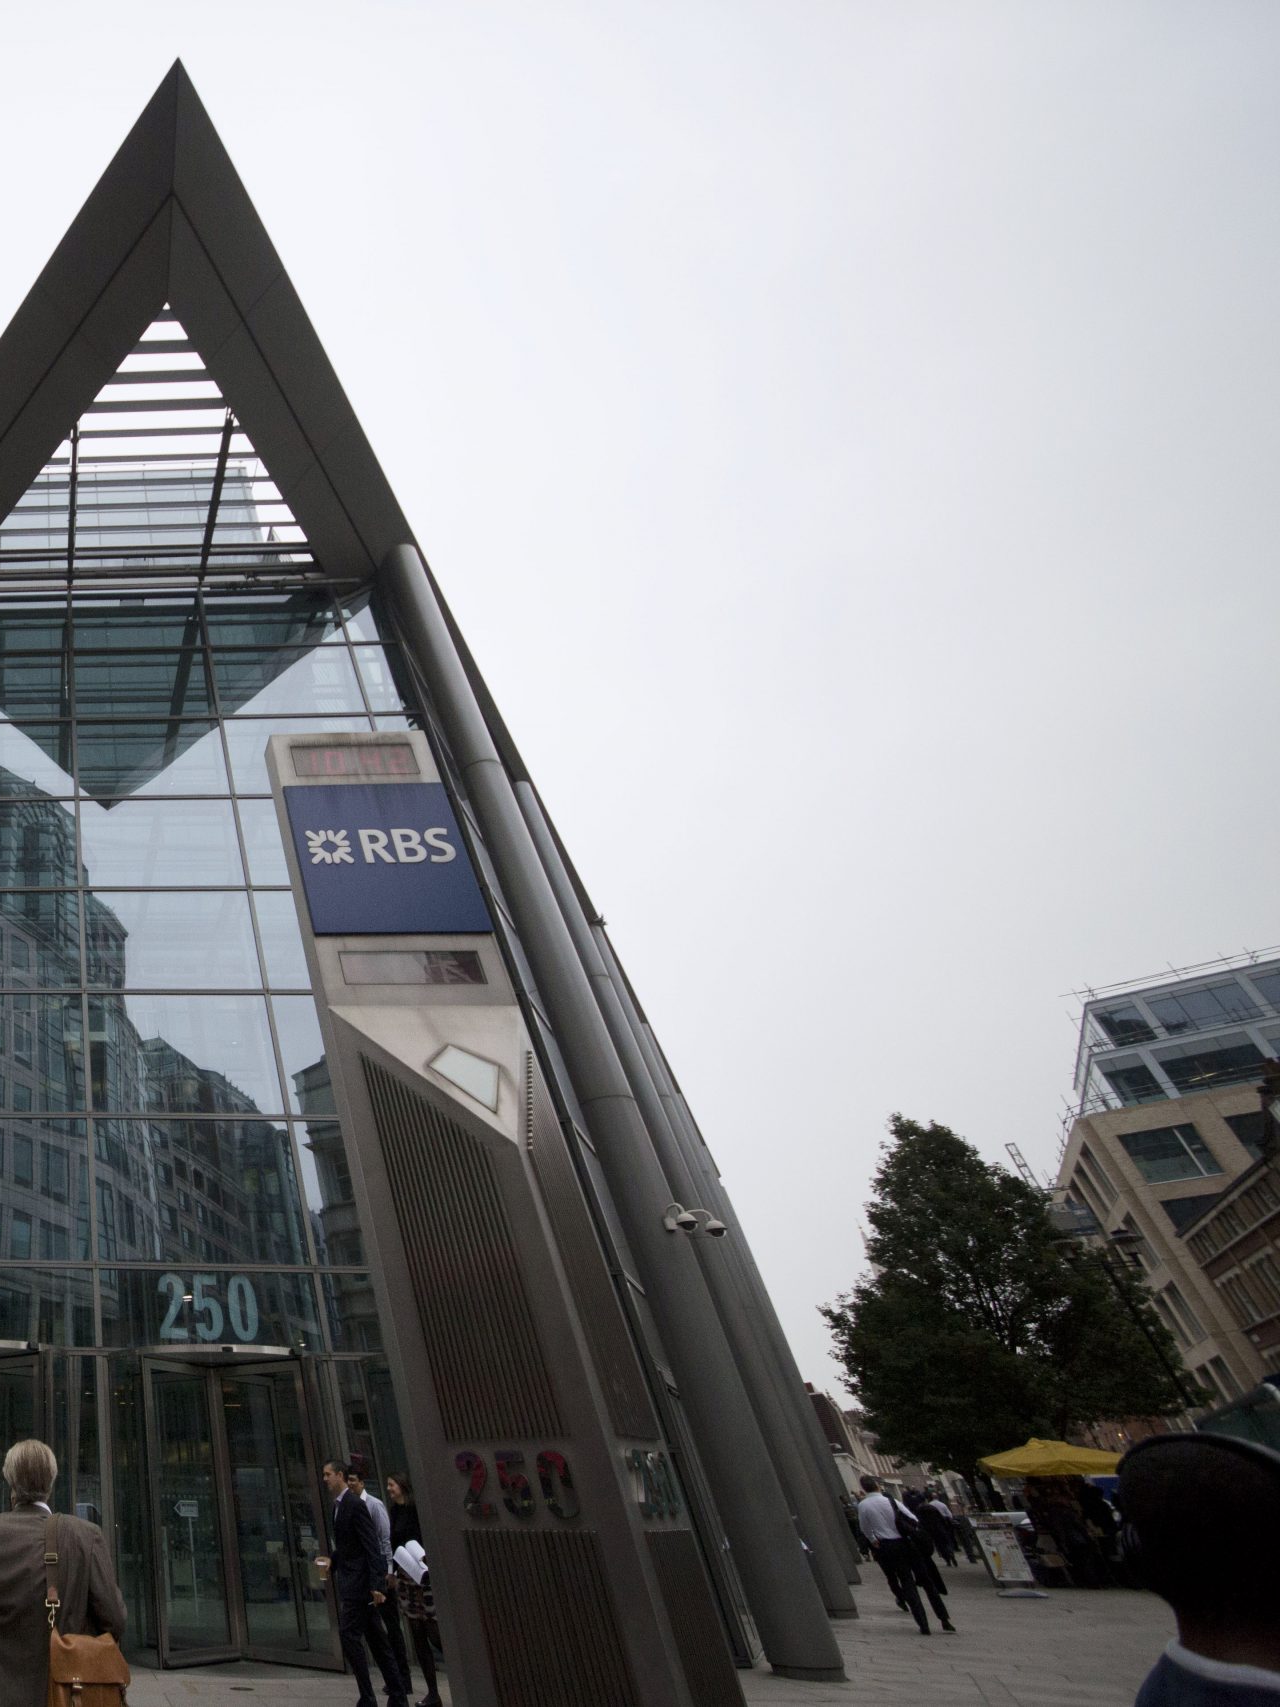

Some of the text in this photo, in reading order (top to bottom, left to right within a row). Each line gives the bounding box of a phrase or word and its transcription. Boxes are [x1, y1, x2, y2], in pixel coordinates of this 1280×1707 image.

[358, 827, 456, 863] RBS
[157, 1273, 259, 1342] 250
[455, 1450, 580, 1520] 250
